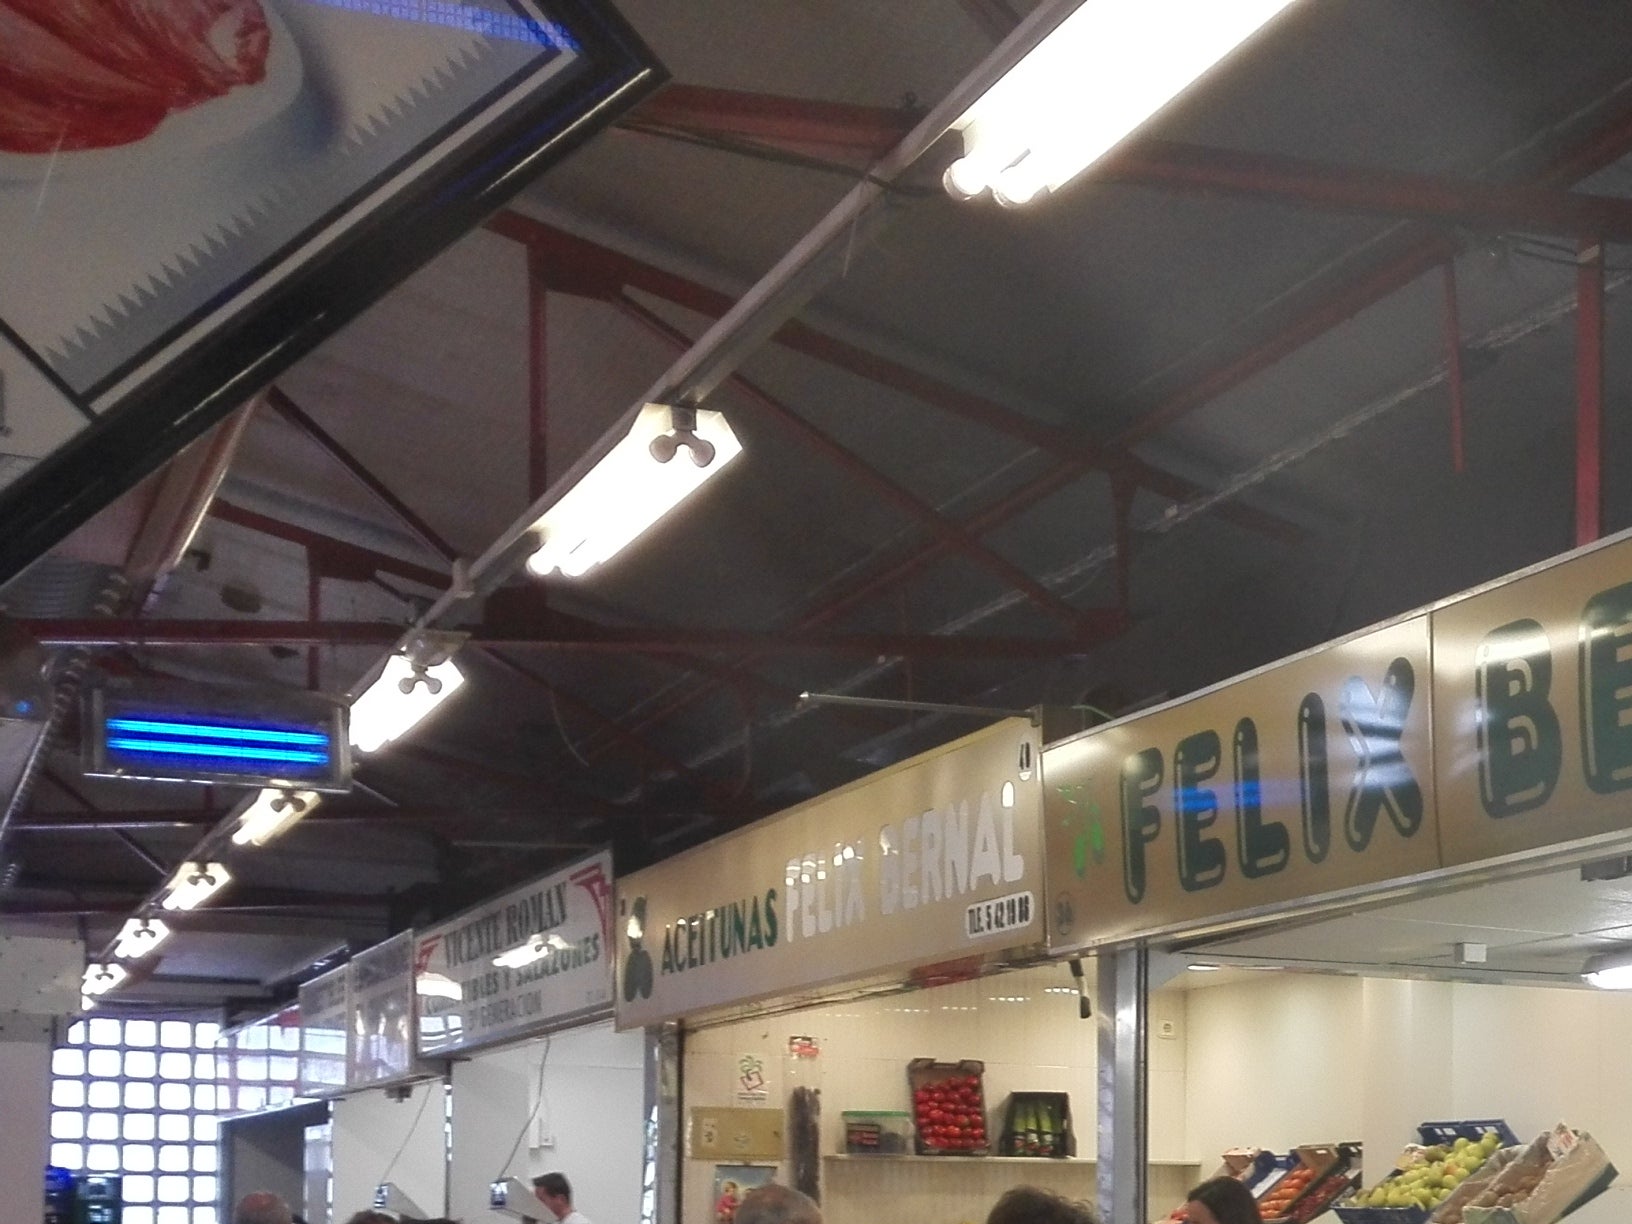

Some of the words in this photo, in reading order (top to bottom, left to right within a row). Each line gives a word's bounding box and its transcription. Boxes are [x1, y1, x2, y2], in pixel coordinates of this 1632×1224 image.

[661, 888, 778, 976] ACEITUNAS
[785, 840, 866, 943] FELIX
[879, 780, 1025, 915] BERNAL
[1120, 656, 1424, 904] FELIX
